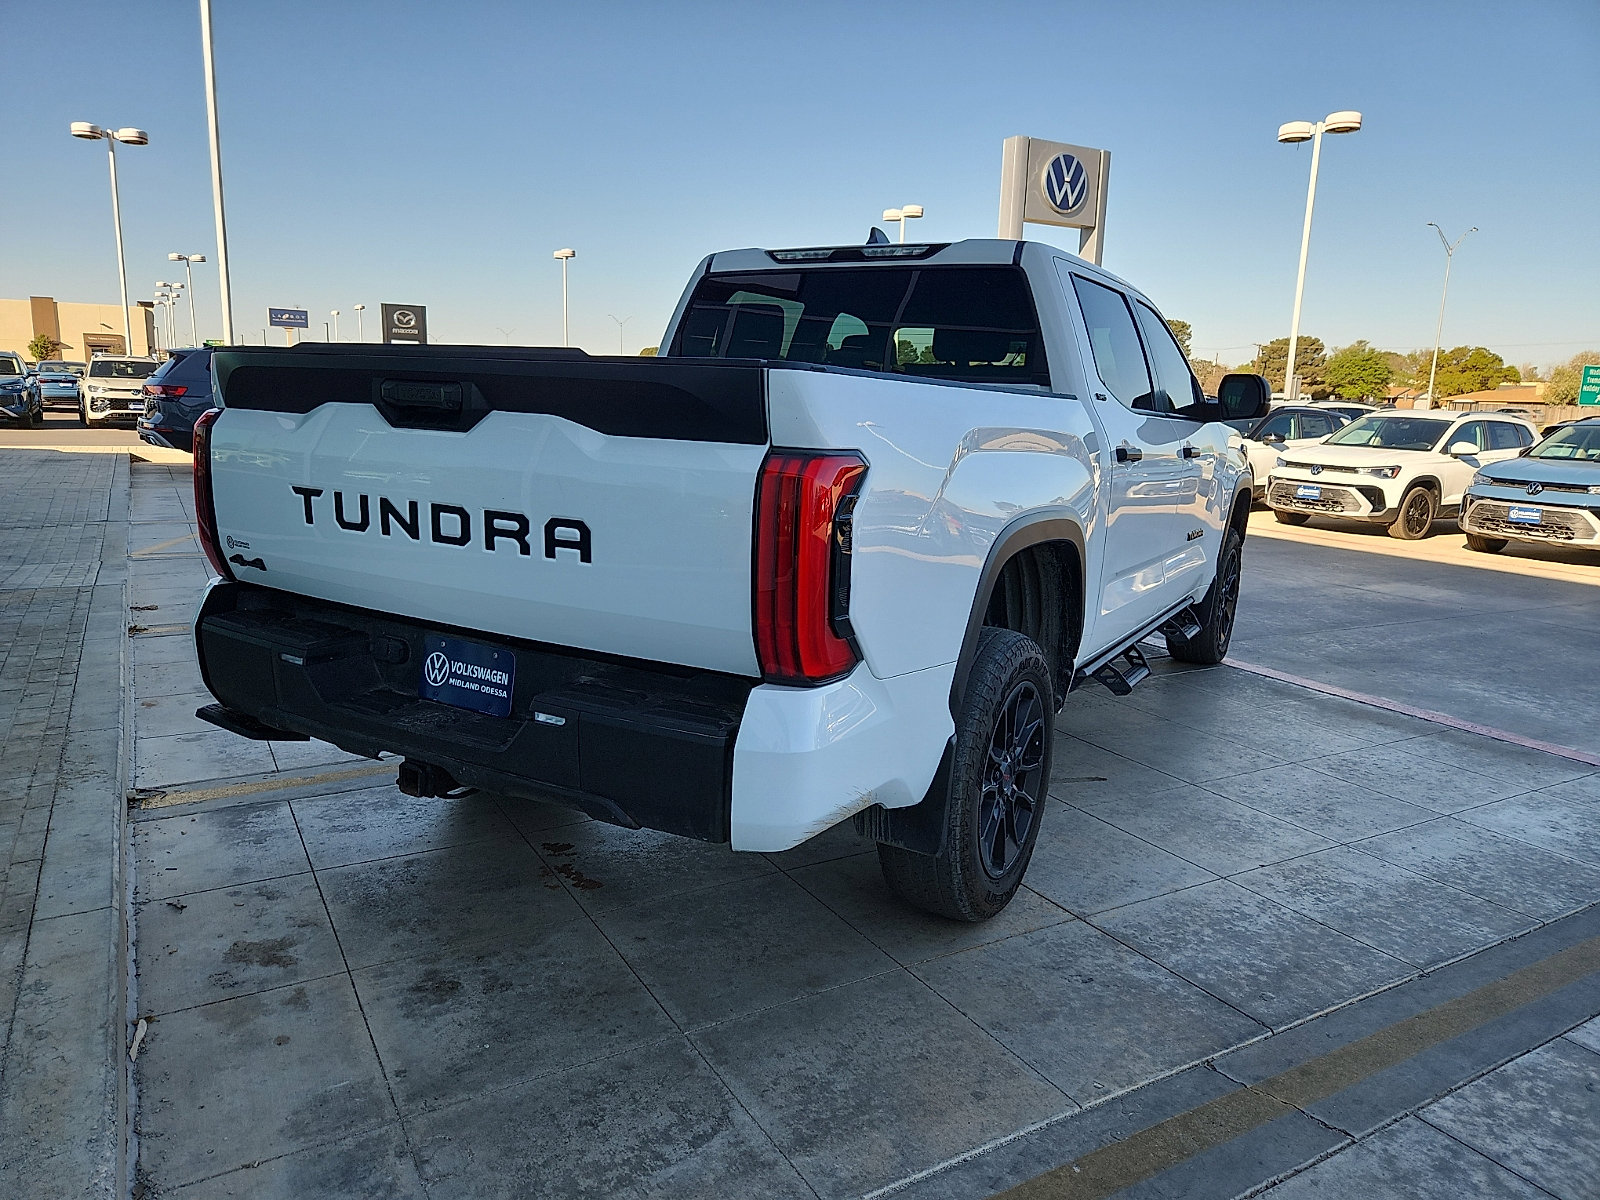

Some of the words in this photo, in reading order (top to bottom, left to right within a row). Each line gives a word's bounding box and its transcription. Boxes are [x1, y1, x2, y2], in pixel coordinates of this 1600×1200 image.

[290, 485, 592, 564] TUNDRA
[451, 660, 509, 685] VOLKSWAGEN
[448, 677, 480, 692] MIDLAND
[480, 685, 508, 698] ODESSA
